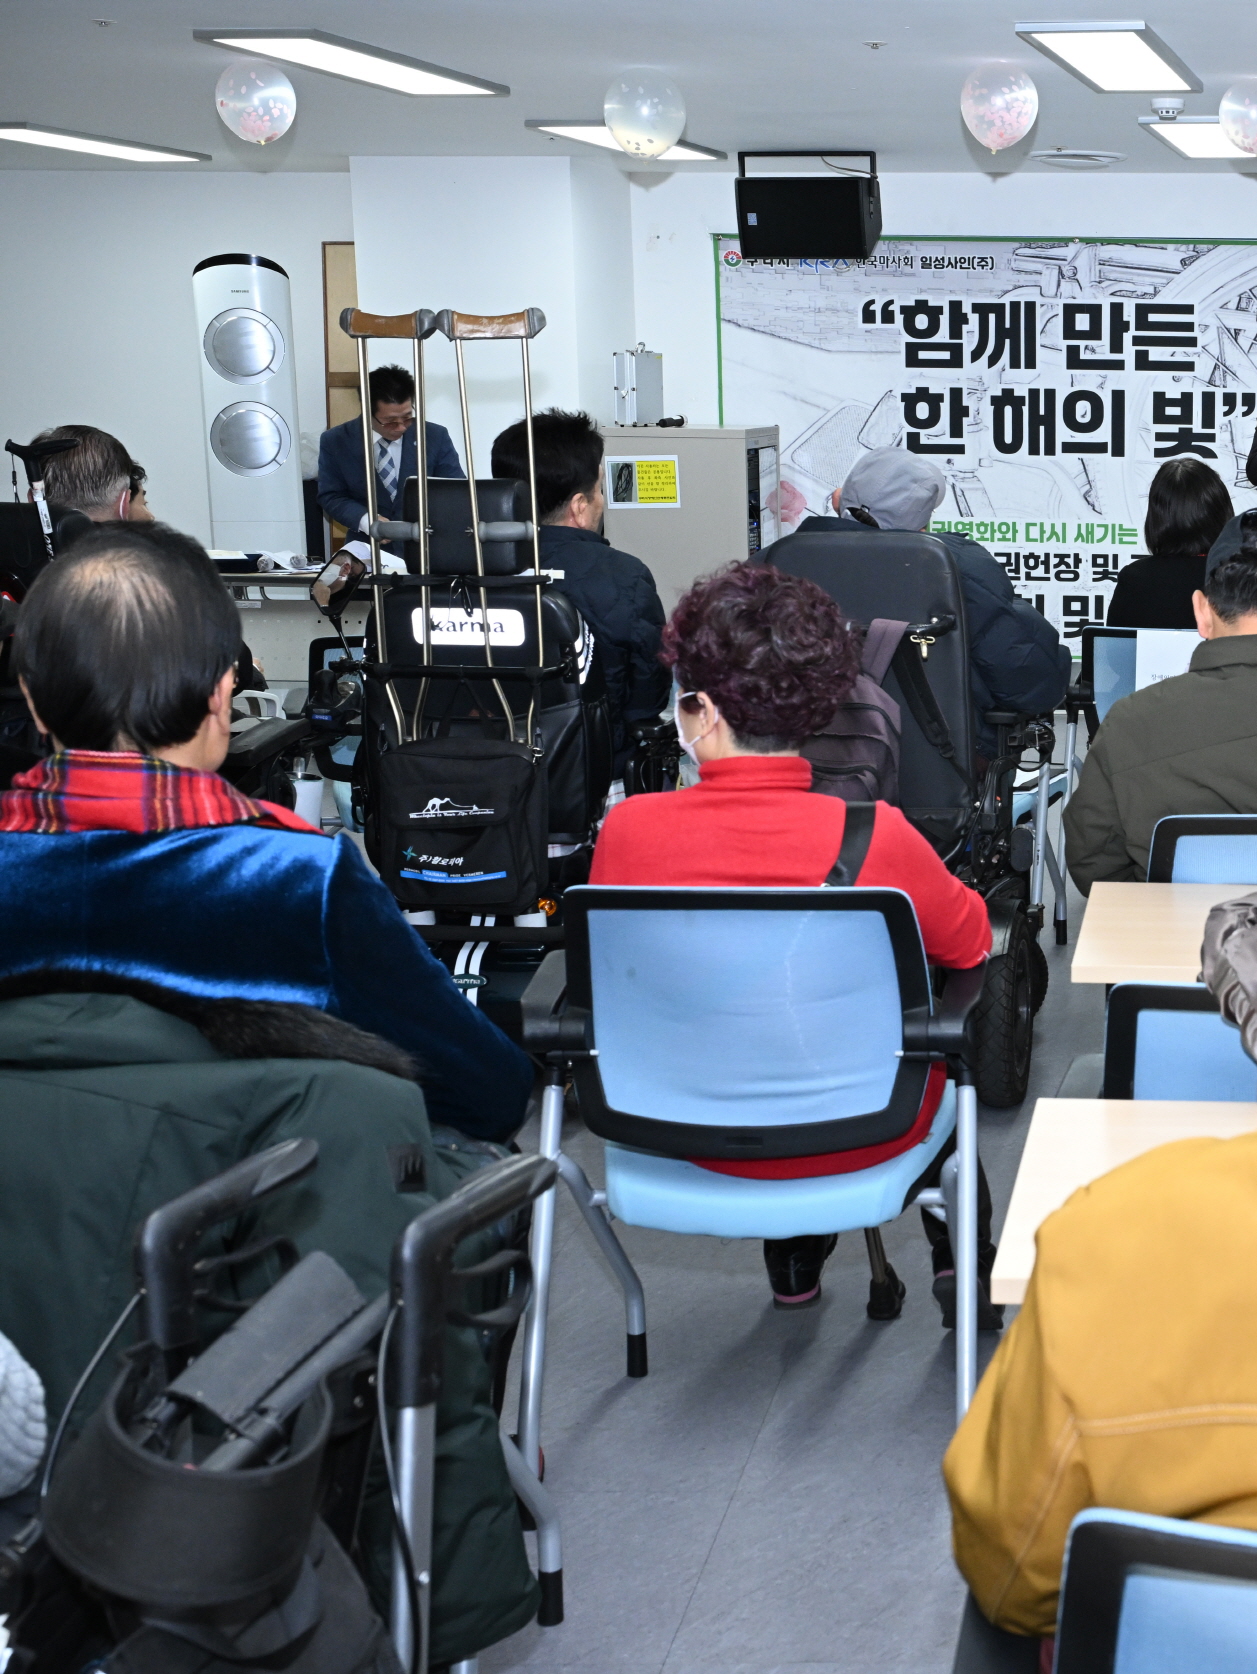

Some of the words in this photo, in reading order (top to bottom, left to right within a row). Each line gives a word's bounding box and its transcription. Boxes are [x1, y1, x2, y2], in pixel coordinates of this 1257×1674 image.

[856, 255, 914, 269] 한국마사회
[920, 256, 995, 270] 일성사인(주)
[1062, 301, 1198, 371] 만든
[901, 386, 969, 455] 한
[990, 388, 1125, 457] 해의
[926, 520, 1018, 542] 권영화와
[1025, 522, 1066, 543] 다시
[1074, 523, 1138, 544] 새기는
[1091, 554, 1119, 582] 및
